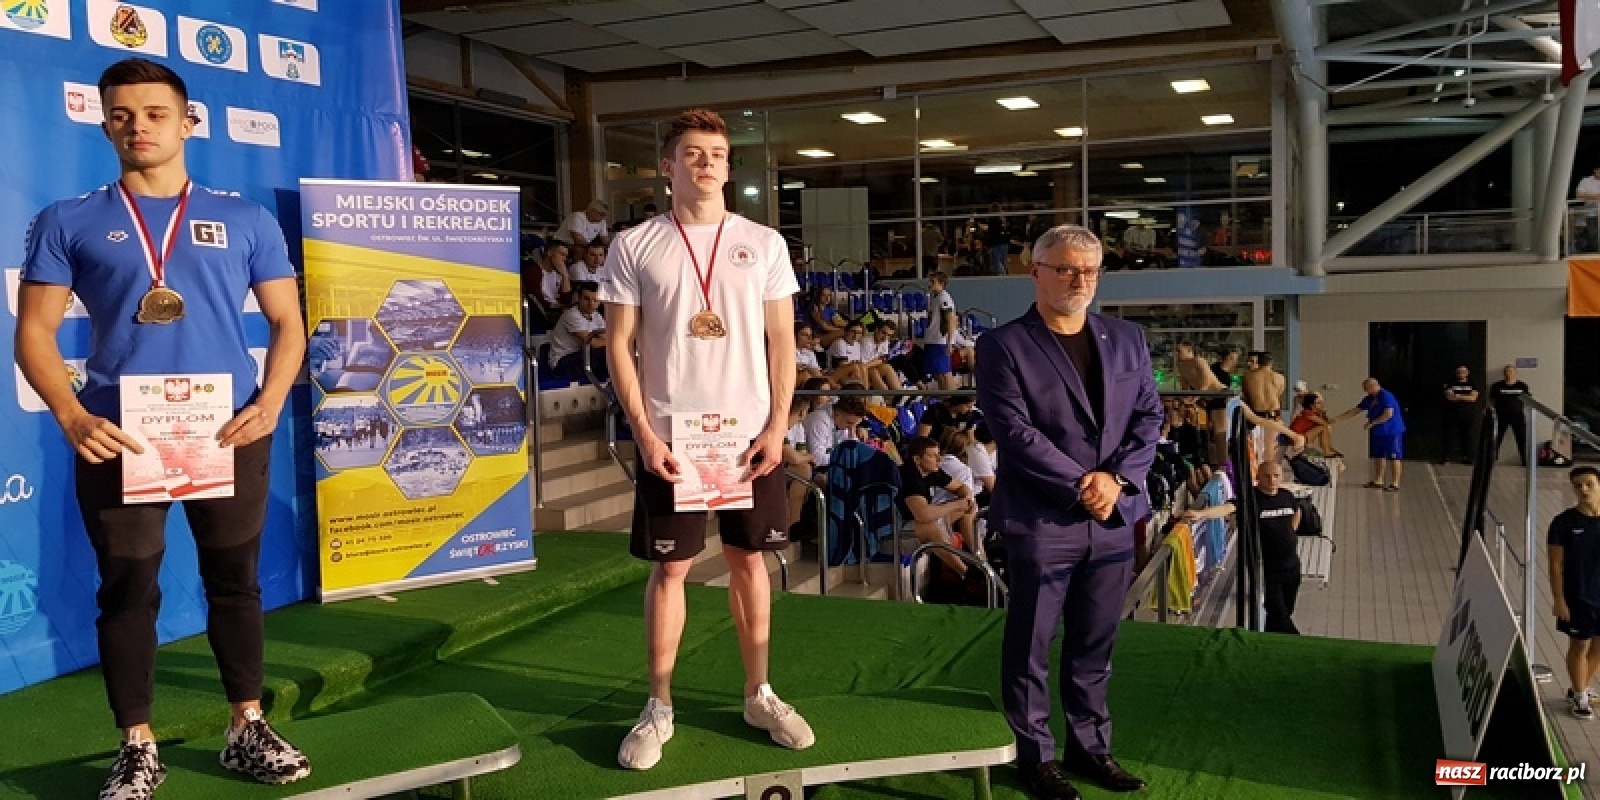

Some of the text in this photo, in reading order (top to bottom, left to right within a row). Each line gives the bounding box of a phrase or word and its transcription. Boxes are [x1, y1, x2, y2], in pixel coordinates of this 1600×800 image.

[336, 194, 511, 213] MIEJSKI OŚRODEK
[312, 212, 512, 231] SPORTU I REKREACJI
[141, 413, 216, 425] DYPLOM
